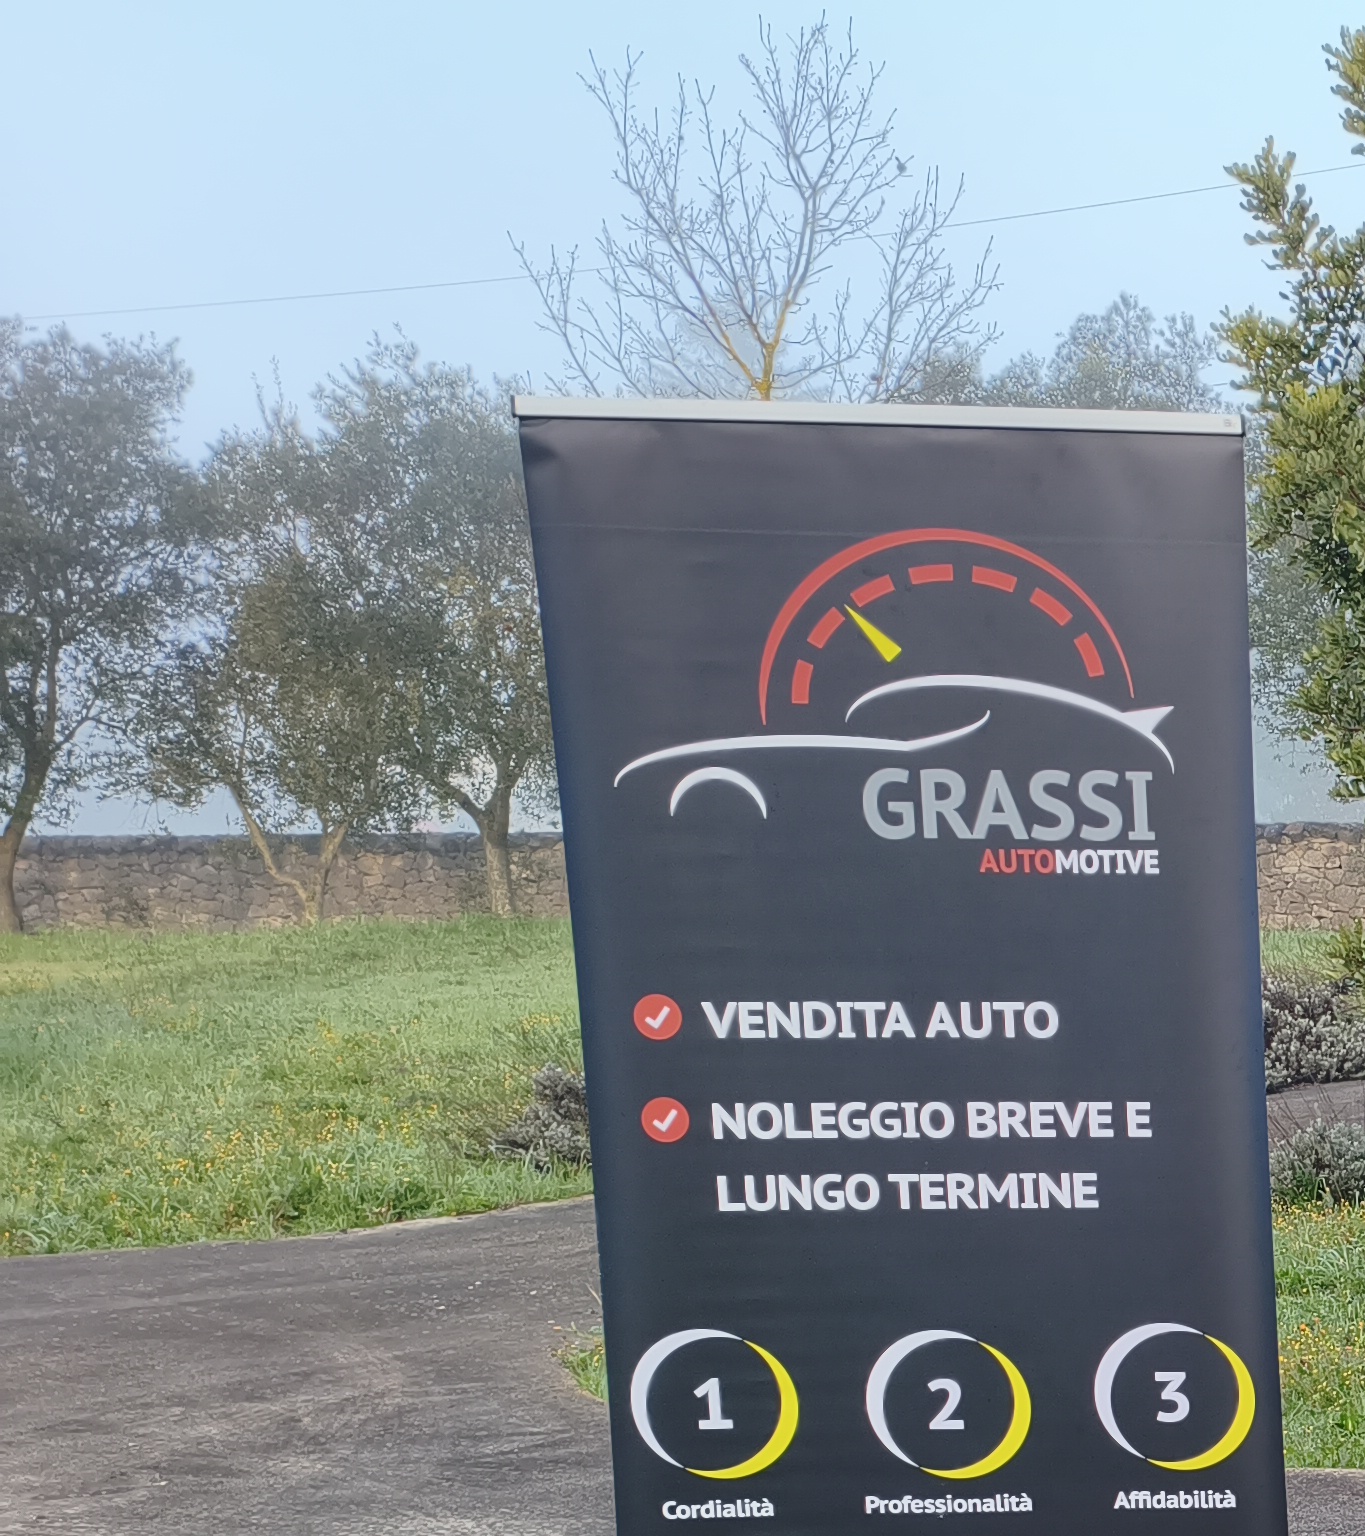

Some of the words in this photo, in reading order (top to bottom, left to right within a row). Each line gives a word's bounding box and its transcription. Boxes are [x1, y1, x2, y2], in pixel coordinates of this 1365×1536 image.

[862, 767, 1156, 842] GRASSI
[979, 848, 1160, 875] AUTOMOTIVE
[700, 1000, 917, 1039] VENDITA
[925, 1000, 1060, 1039] AUTO
[711, 1101, 955, 1140] NOLEGGIO
[966, 1101, 1115, 1139] BREVE
[1126, 1101, 1153, 1138] E
[716, 1173, 880, 1212] LUNGO
[887, 1172, 1100, 1210] TERMINE
[693, 1377, 734, 1430] 1
[927, 1378, 965, 1430] 2
[1154, 1371, 1190, 1423] 3
[661, 1497, 775, 1520] Cordialità
[864, 1492, 1033, 1515] Professionalità
[1113, 1489, 1237, 1510] Affidabilità
